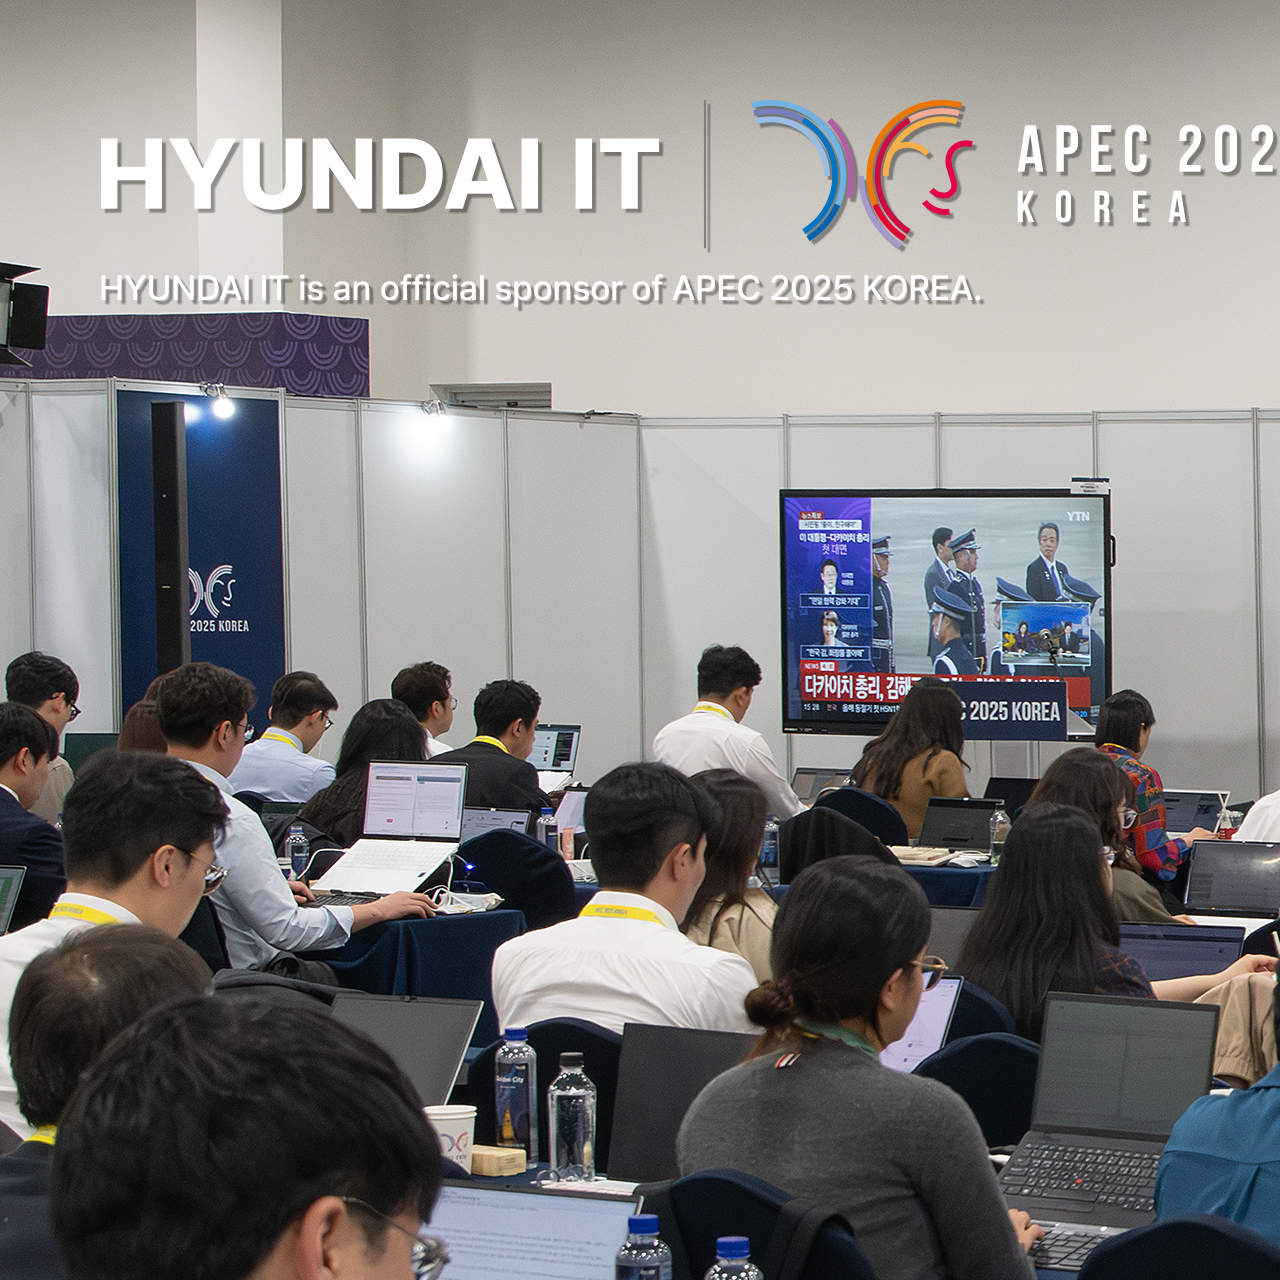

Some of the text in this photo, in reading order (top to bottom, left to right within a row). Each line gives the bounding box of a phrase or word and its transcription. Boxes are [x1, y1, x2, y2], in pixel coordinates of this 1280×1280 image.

[1066, 511, 1090, 522] YTN
[822, 544, 848, 556] 첫 대면
[190, 620, 250, 632] 2025 KOREA
[804, 674, 922, 701] 다카이치 총리, 김해
[969, 700, 1009, 721] 2025
[1011, 701, 1061, 722] KOREA
